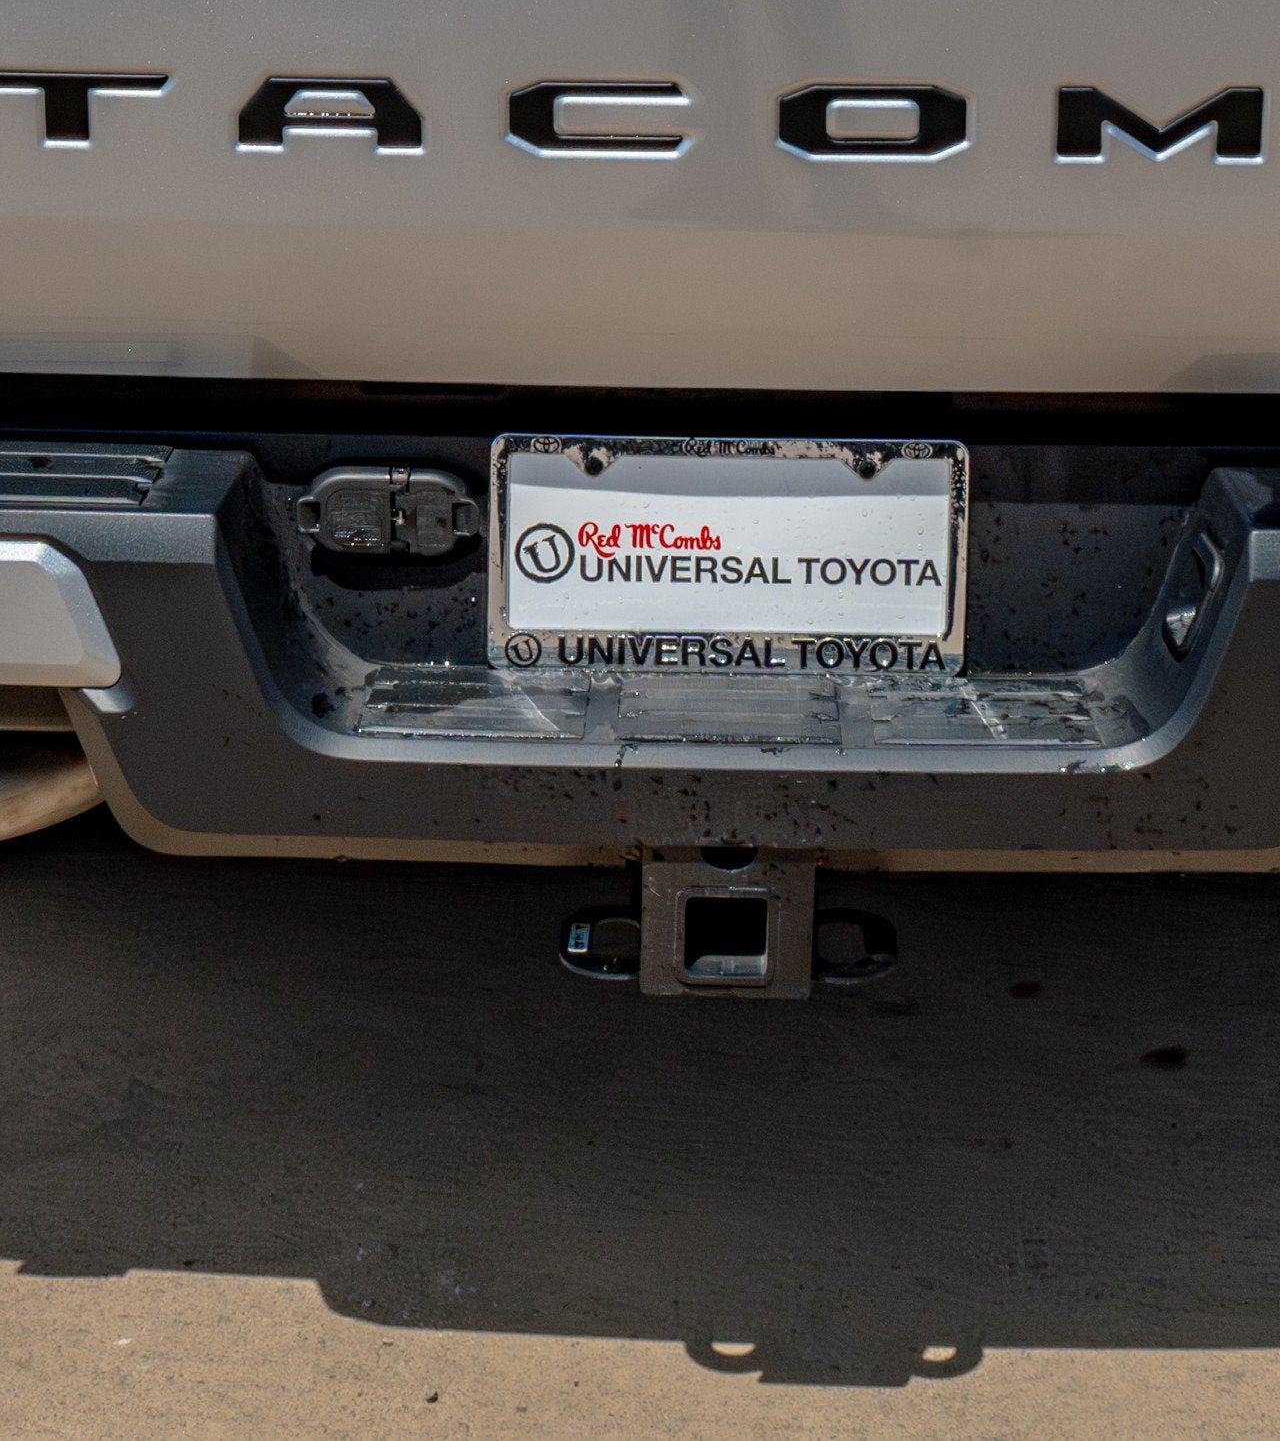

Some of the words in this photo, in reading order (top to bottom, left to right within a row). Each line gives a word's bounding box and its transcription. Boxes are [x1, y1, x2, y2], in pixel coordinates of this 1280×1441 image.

[684, 438, 713, 457] Red
[578, 522, 621, 559] Red
[625, 524, 721, 551] McCombs
[579, 555, 792, 584] UNIVERSAL
[798, 557, 942, 587] TOYOTA
[556, 634, 786, 669] UNIVERSAL
[792, 637, 946, 671] TOYOTA
